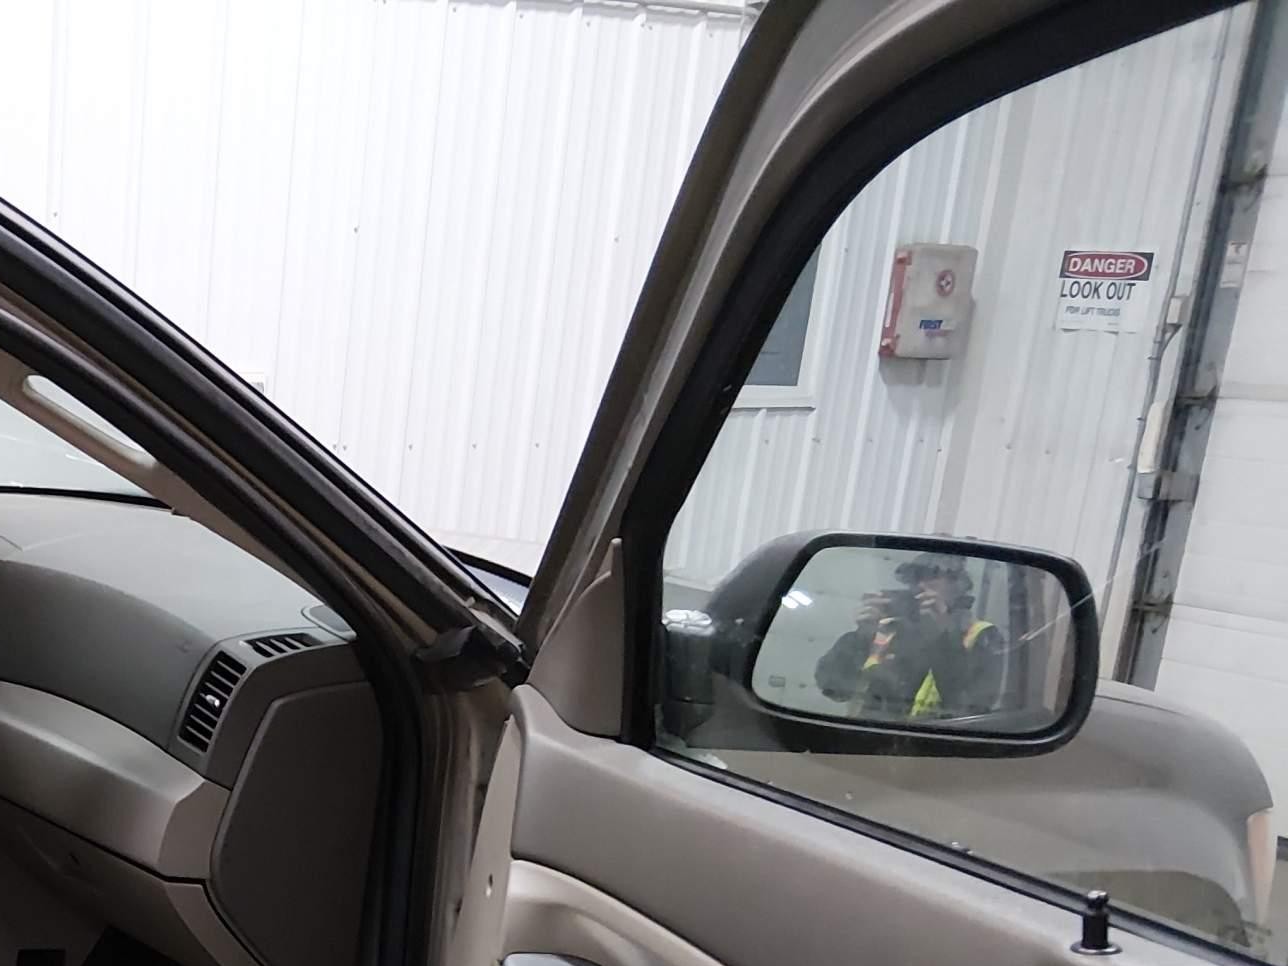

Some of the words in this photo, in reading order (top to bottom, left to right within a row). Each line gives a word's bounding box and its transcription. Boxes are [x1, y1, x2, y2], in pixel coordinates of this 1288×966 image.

[1068, 257, 1136, 274] DANGER
[1060, 280, 1103, 299] LOOK
[1106, 282, 1136, 300] OUT
